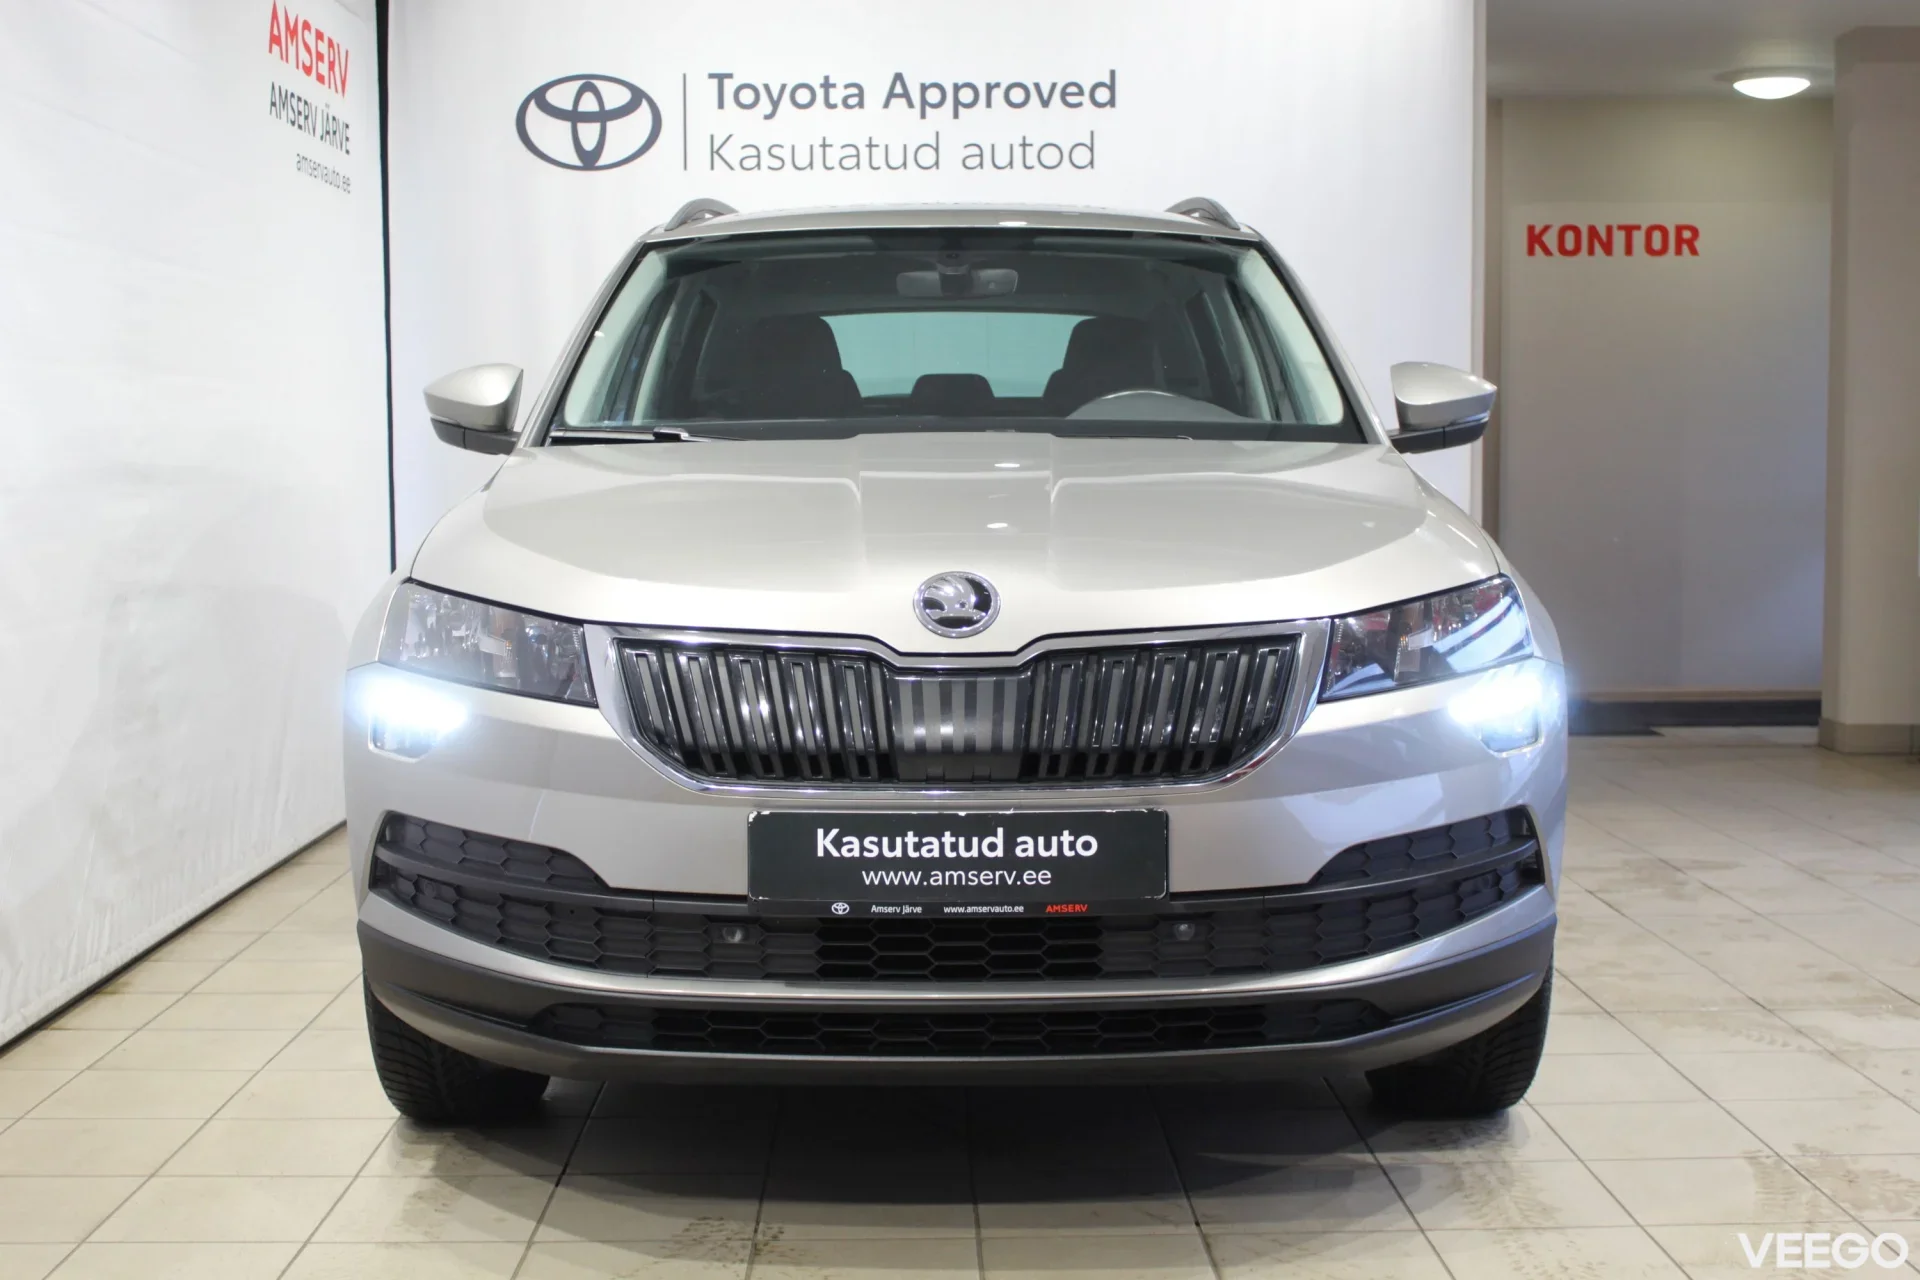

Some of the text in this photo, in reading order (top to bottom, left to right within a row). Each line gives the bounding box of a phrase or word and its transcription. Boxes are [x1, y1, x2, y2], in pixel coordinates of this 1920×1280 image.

[268, 0, 349, 98] AMSERV
[708, 69, 1117, 120] Toyota Approved
[269, 81, 351, 155] AMSERV JÄRVE
[709, 130, 1096, 171] Kasutatud autod
[296, 152, 351, 194] amservauto.ee
[1526, 223, 1700, 257] KONTOR
[817, 827, 1098, 858] Kasutatud auto
[862, 868, 1052, 886] www.amserv.ee
[870, 903, 922, 915] Amserv Järve
[943, 903, 1024, 914] www.amservauto.ee
[1045, 904, 1088, 913] AMSERV
